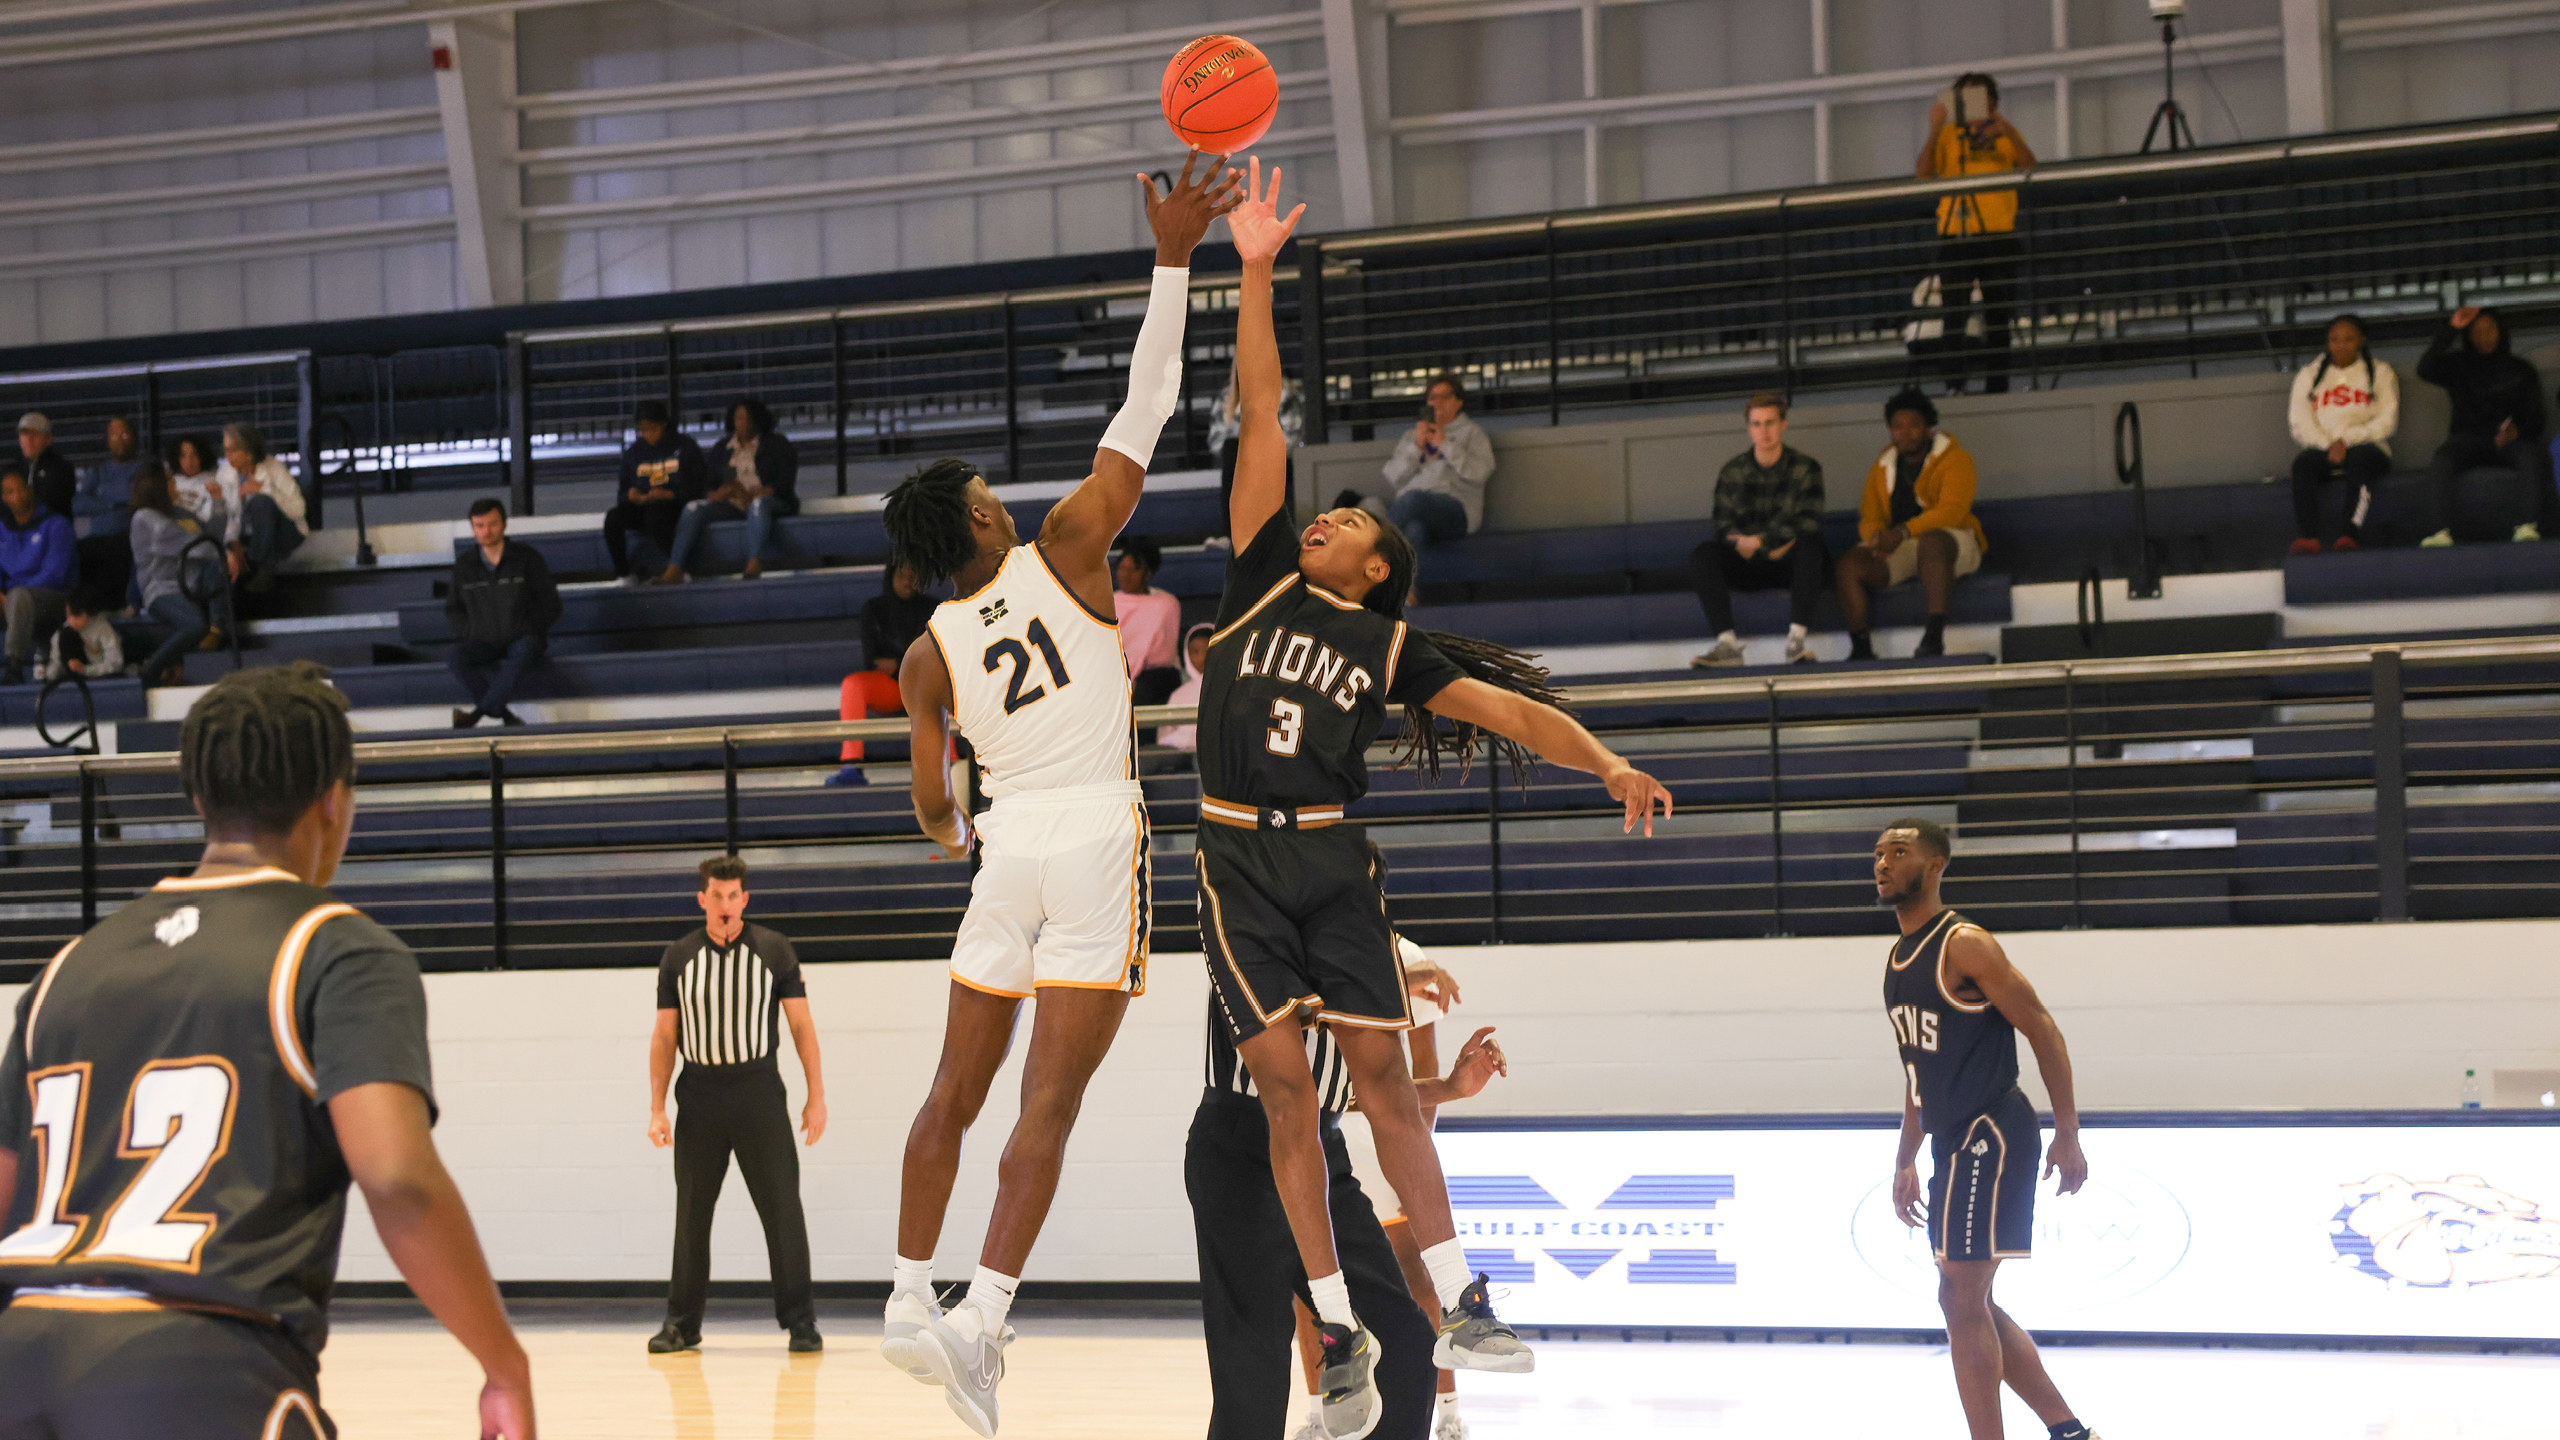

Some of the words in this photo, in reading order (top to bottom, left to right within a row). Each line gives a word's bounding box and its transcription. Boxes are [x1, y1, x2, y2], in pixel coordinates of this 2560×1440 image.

[1183, 44, 1255, 94] SPALDING
[982, 615, 1072, 716] 21
[1236, 626, 1373, 713] LIONS
[1266, 697, 1304, 757] 3
[0, 1055, 239, 1274] 12
[1571, 1221, 1725, 1236] COAST
